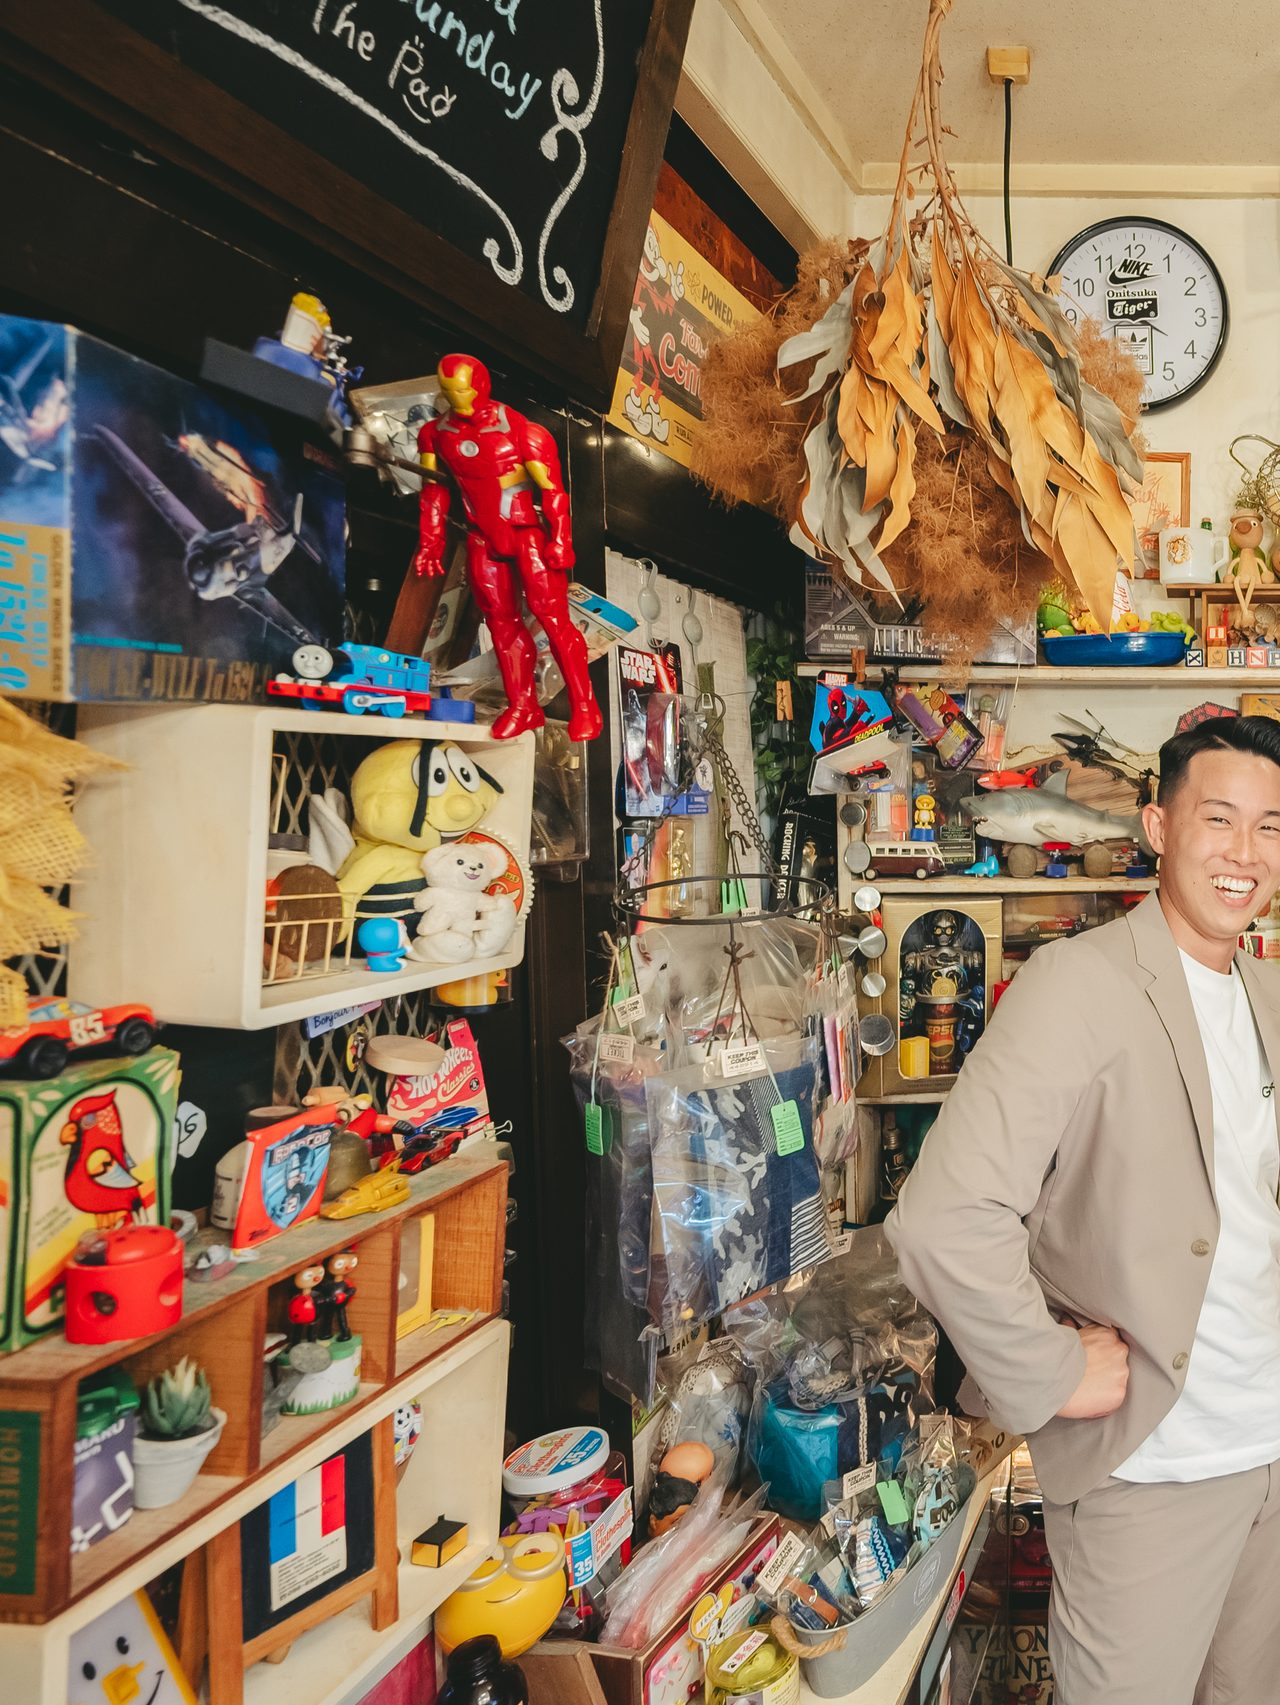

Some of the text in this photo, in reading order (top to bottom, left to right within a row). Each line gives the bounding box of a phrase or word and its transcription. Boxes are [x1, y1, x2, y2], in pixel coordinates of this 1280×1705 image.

[398, 0, 542, 119] unday
[1124, 244, 1147, 260] 12
[1094, 255, 1114, 273] 11
[1118, 258, 1153, 277] NIKE
[1162, 254, 1171, 274] 1
[1073, 278, 1095, 297] 10
[1106, 289, 1157, 298] Onitsuka
[1184, 277, 1197, 297] 2
[701, 284, 734, 328] POWER
[1113, 300, 1152, 317] Tiger
[1194, 307, 1207, 327] 3
[1184, 340, 1197, 359] 4
[1162, 361, 1175, 381] 5
[834, 633, 860, 641] WARNING:
[874, 629, 923, 653] ALIENS
[621, 651, 656, 669] STAR
[1188, 651, 1201, 665] X
[1231, 651, 1244, 664] H
[621, 664, 656, 684] WARS
[825, 672, 848, 686] MARVEL
[854, 724, 885, 743] DEADPOOL
[313, 1006, 351, 1029] Bonjour
[69, 1012, 107, 1047] 85
[728, 1052, 744, 1060] KEEP
[730, 1055, 757, 1065] COUPON
[406, 1072, 438, 1099] HOT
[437, 1061, 475, 1102] Classics
[286, 1195, 298, 1214] 2
[561, 1449, 585, 1466] 35
[847, 1474, 860, 1484] KEEP
[849, 1475, 871, 1487] COUPON
[596, 1508, 633, 1552] Clothespins
[574, 1556, 593, 1578] 35
[764, 1539, 793, 1580] KEEP THIS
[769, 1546, 794, 1578] COUPON
